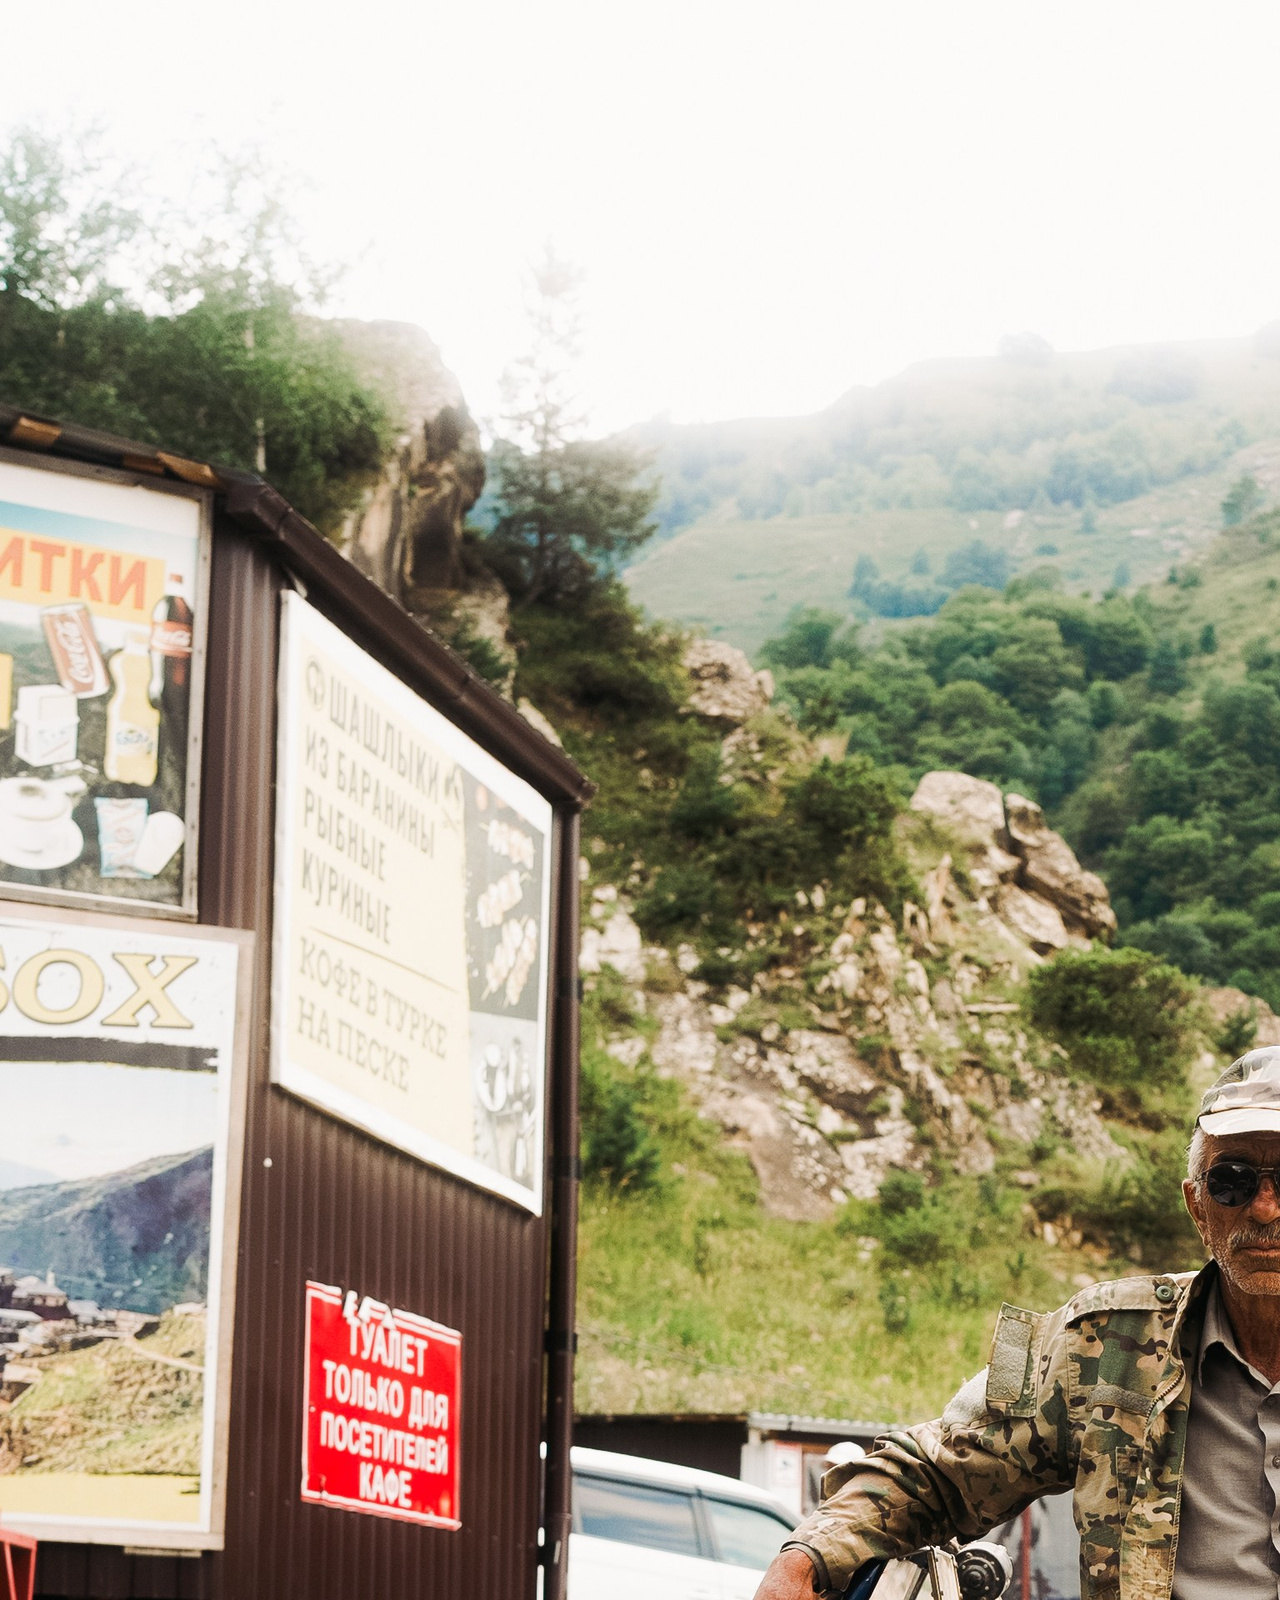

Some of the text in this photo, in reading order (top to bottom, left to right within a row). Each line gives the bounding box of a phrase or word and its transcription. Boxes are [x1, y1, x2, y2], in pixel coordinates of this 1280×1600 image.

[329, 676, 439, 804] ШАШЛЫКИ
[304, 787, 386, 882] РЫБНЫЕ
[305, 725, 434, 858] ИЗ БАРАНИНЫ
[302, 848, 391, 945] КУРИНЫЕ
[297, 995, 410, 1092] НА ПЕСКЕ
[299, 936, 448, 1060] КОФЕ В ТУРКЕ
[346, 1316, 428, 1378] ТУАЛЕТ
[320, 1411, 449, 1476] ПОСЕТИТЕЛЕЙ
[322, 1359, 449, 1432] ТОЛЬКО ДЛЯ
[359, 1461, 413, 1508] КАФЕ
